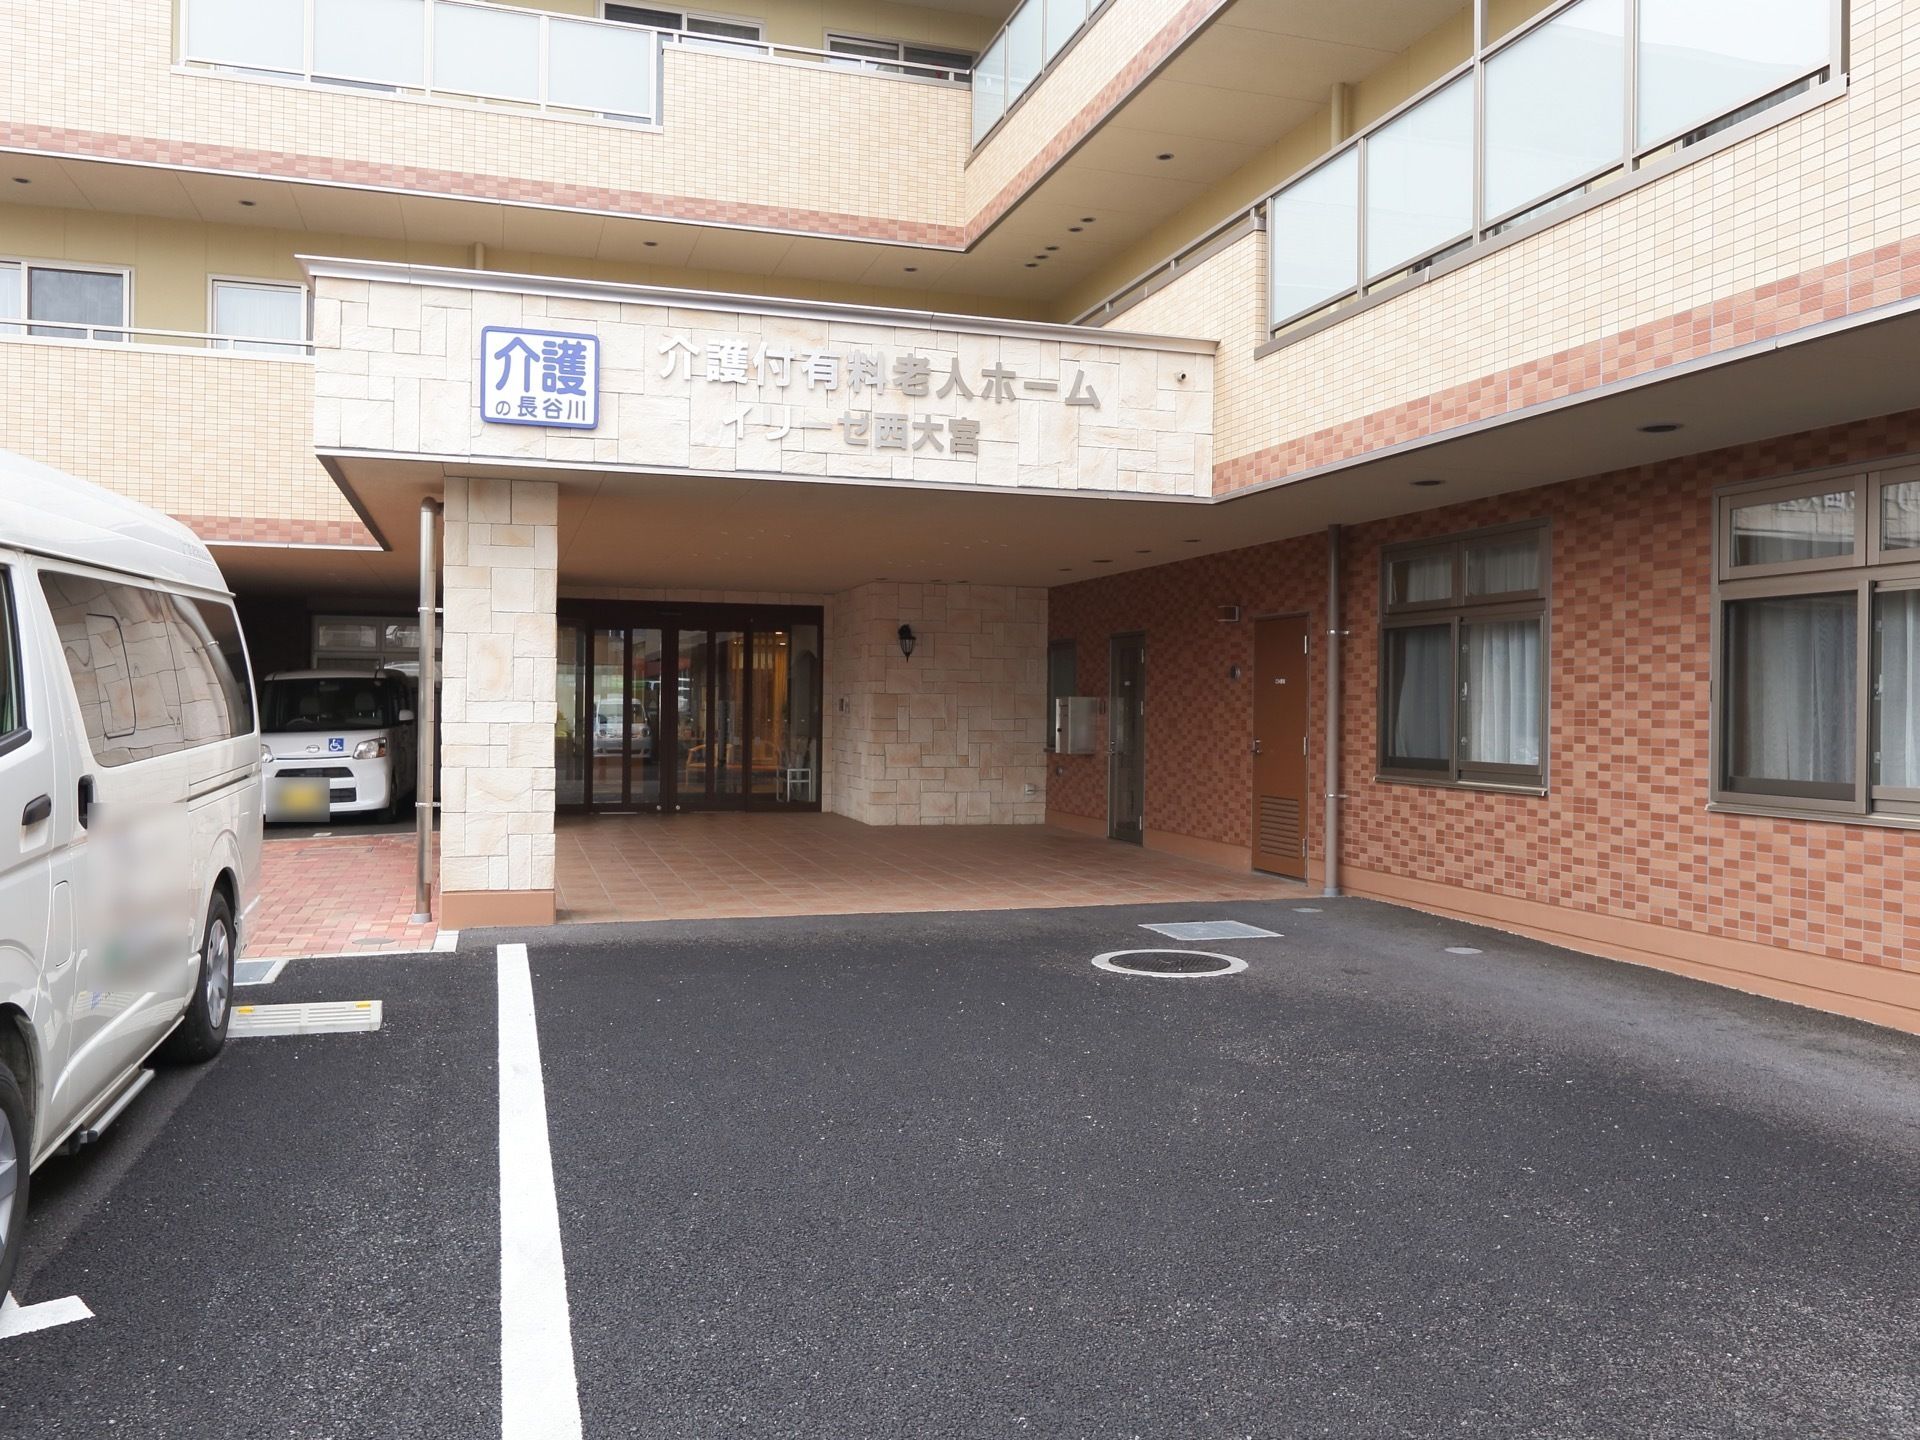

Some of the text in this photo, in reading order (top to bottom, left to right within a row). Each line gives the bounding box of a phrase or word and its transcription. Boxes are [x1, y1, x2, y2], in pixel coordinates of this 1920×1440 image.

[494, 336, 587, 396] 介護
[658, 334, 1100, 409] 介護付有料老人ホーム
[495, 396, 586, 421] の長谷川
[722, 405, 980, 454] イリーゼ西大宮
